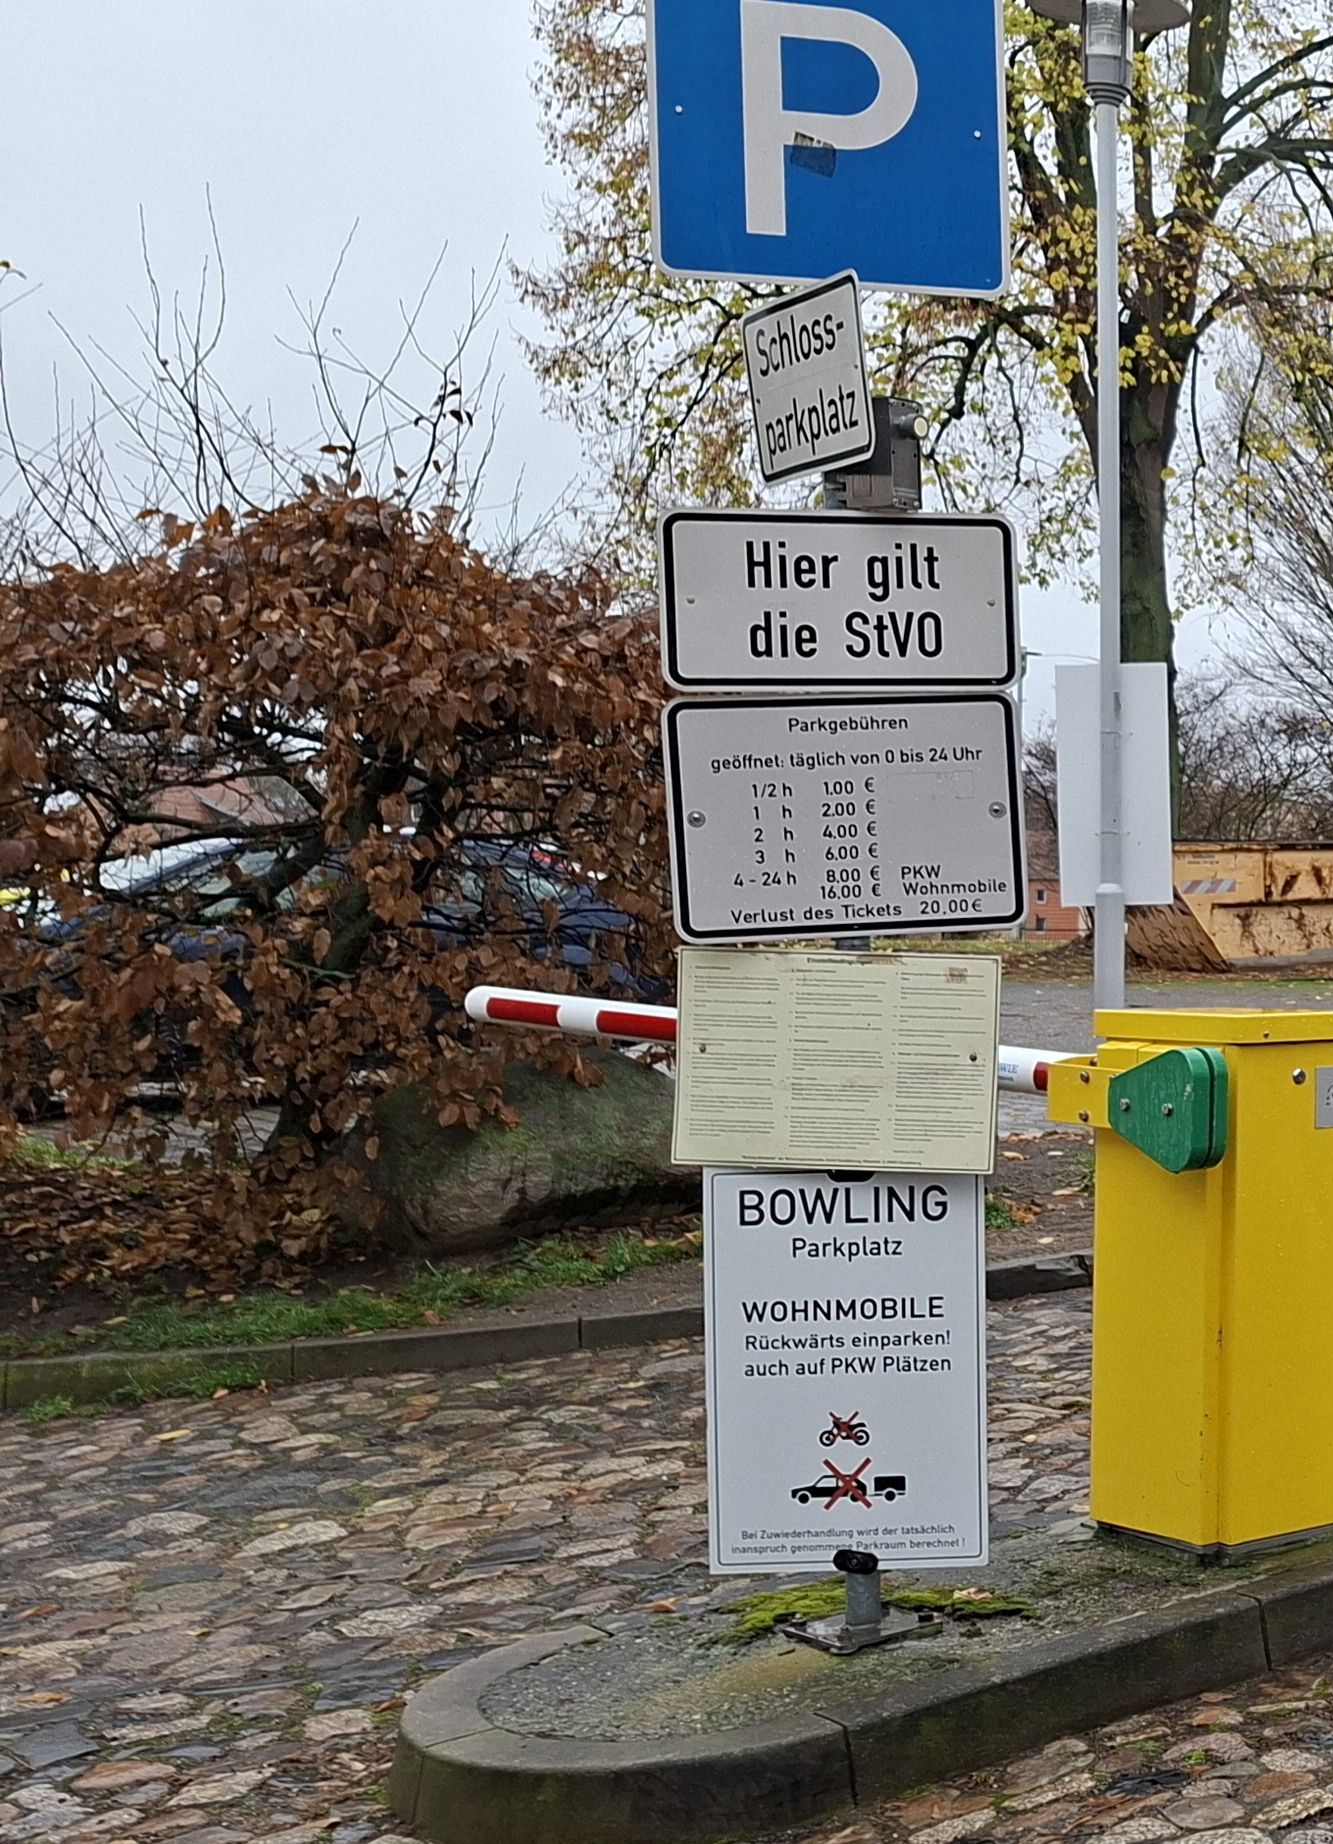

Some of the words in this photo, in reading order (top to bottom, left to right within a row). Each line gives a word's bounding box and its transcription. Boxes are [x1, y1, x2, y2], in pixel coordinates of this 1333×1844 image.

[740, 0, 919, 236] P
[755, 313, 845, 378] Schloss-
[765, 384, 859, 471] parkplatz
[745, 540, 839, 589] Hier
[866, 542, 941, 603] gilt
[749, 610, 818, 659] die
[845, 611, 943, 659] StVO
[788, 715, 909, 735] Parkgebühren
[711, 753, 784, 774] geöffnet:
[789, 750, 846, 771] täglich
[850, 753, 880, 765] von
[884, 749, 895, 764] 0
[899, 748, 924, 764] bis
[928, 747, 949, 763] 24
[952, 746, 983, 761] Uhr
[751, 783, 777, 799] 1/2
[782, 782, 793, 797] h
[864, 776, 875, 793] €
[753, 805, 760, 821] 1
[781, 804, 793, 819] h
[865, 798, 876, 815] €
[753, 827, 764, 843] 2
[783, 826, 794, 841] h
[866, 820, 877, 837] €
[755, 849, 765, 865] 3
[784, 848, 796, 863] h
[867, 842, 879, 859] €
[733, 873, 744, 887] 4
[761, 871, 782, 887] 24
[786, 870, 797, 886] h
[869, 866, 881, 882] €
[901, 865, 941, 880] PKW
[871, 884, 882, 898] €
[902, 880, 1007, 897] Wohnmobile
[730, 908, 795, 925] Verlust
[803, 906, 834, 921] des
[841, 903, 903, 919] Tickets
[739, 1184, 950, 1227] BOWLING
[792, 1235, 903, 1263] Parkplatz
[741, 1296, 945, 1323] WOHNMOBILE
[745, 1333, 845, 1351] Rückwärts
[851, 1329, 950, 1351] einparken!
[744, 1359, 789, 1377] auch
[795, 1357, 826, 1376] auf
[831, 1356, 877, 1375] PKW
[882, 1355, 951, 1373] Plätzen
[855, 1527, 879, 1537] wird
[881, 1526, 899, 1536] der
